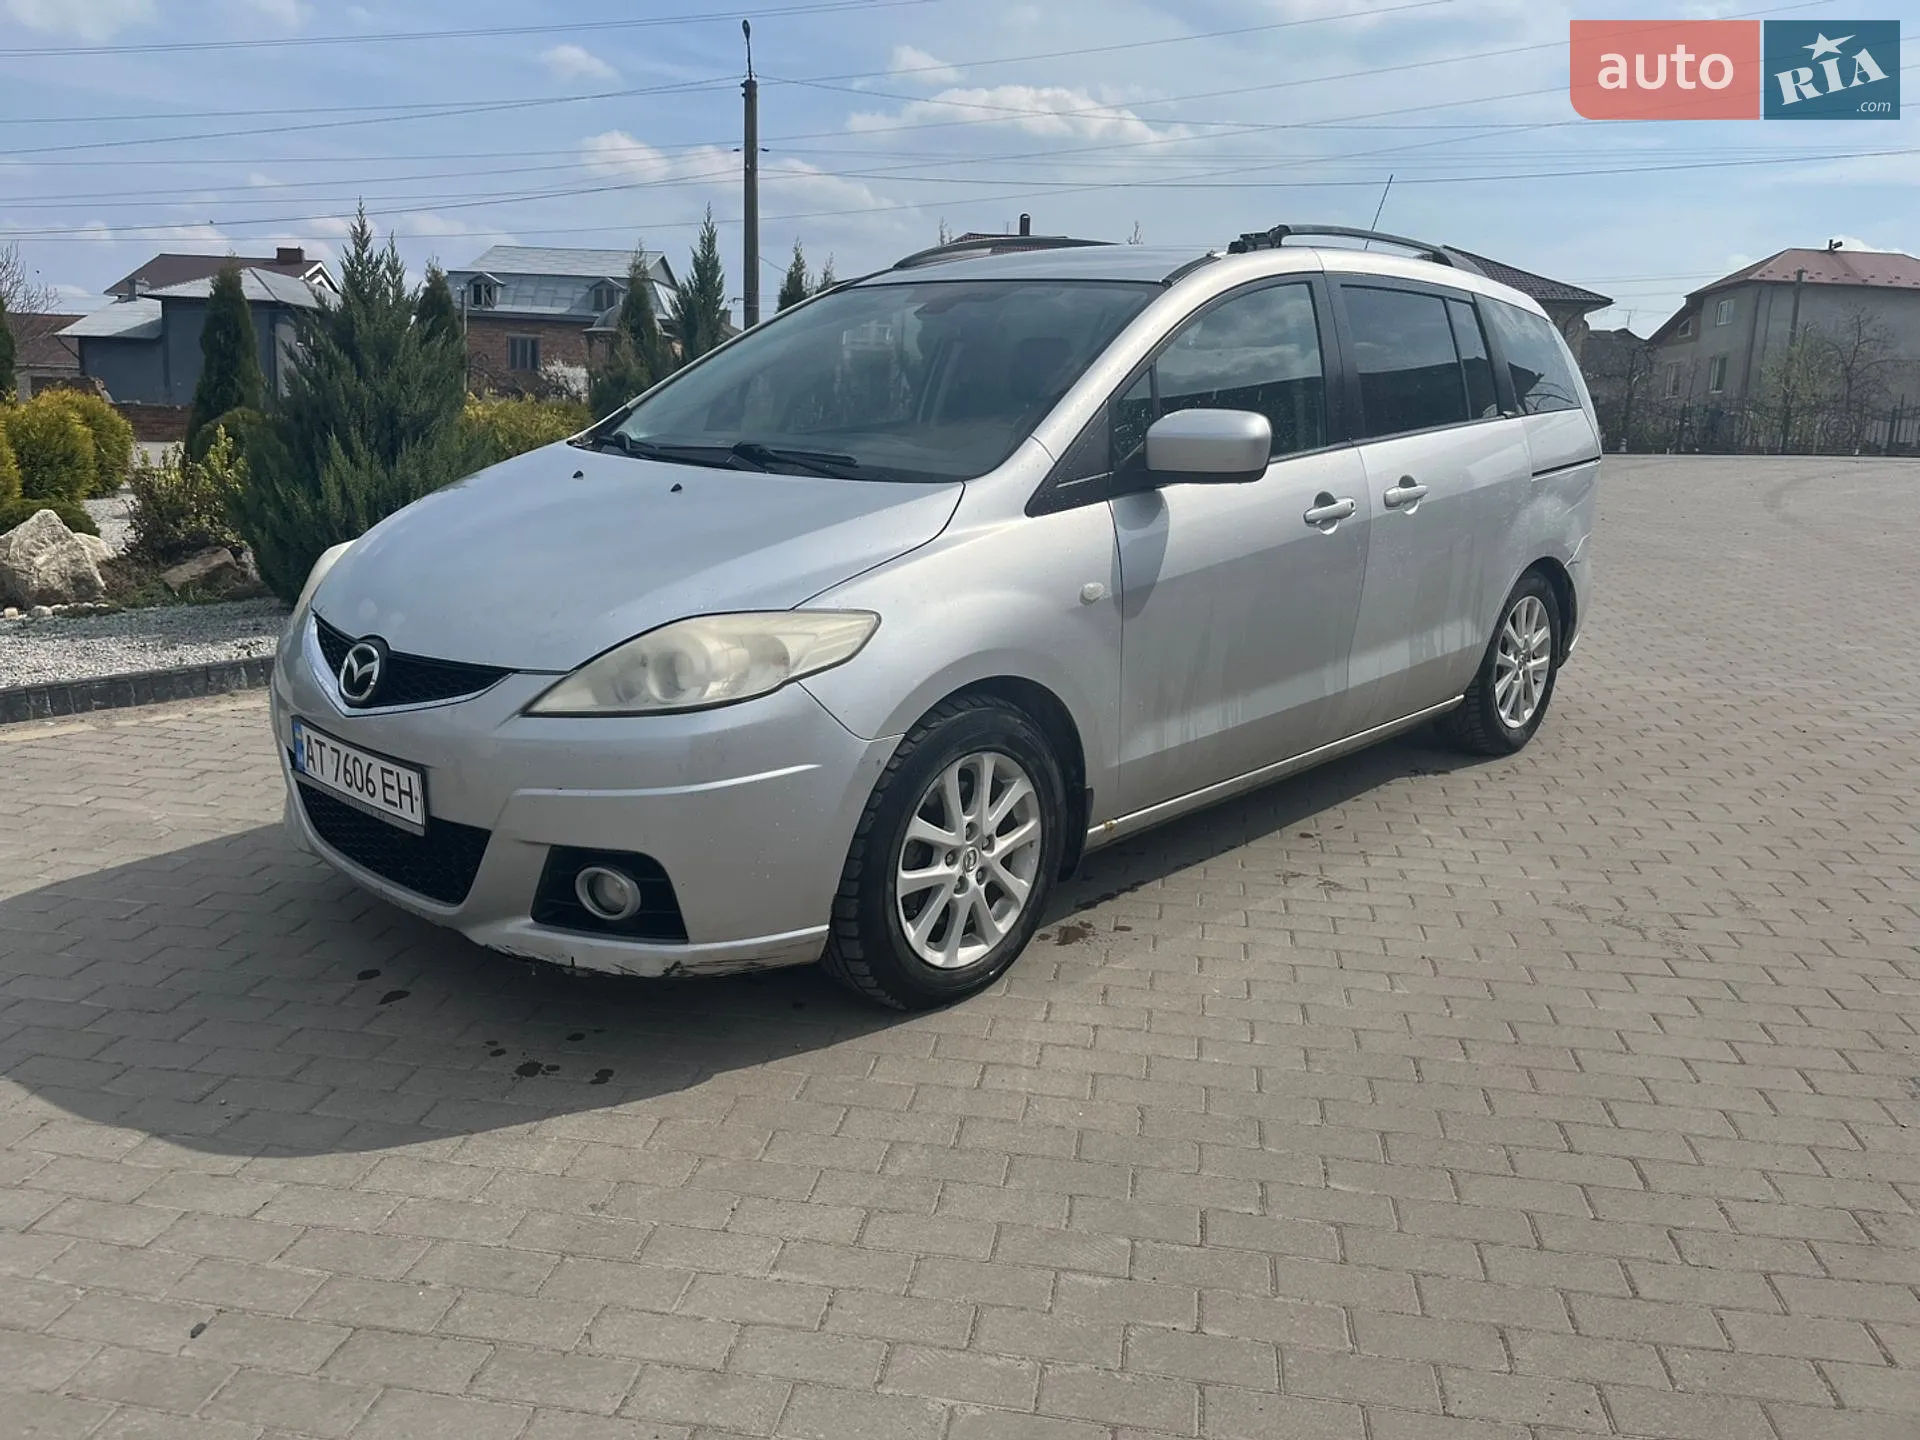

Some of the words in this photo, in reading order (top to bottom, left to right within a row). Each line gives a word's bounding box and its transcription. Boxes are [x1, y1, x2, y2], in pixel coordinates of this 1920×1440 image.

[307, 734, 326, 776] AT
[330, 746, 376, 798] 7606
[381, 766, 414, 814] EH
